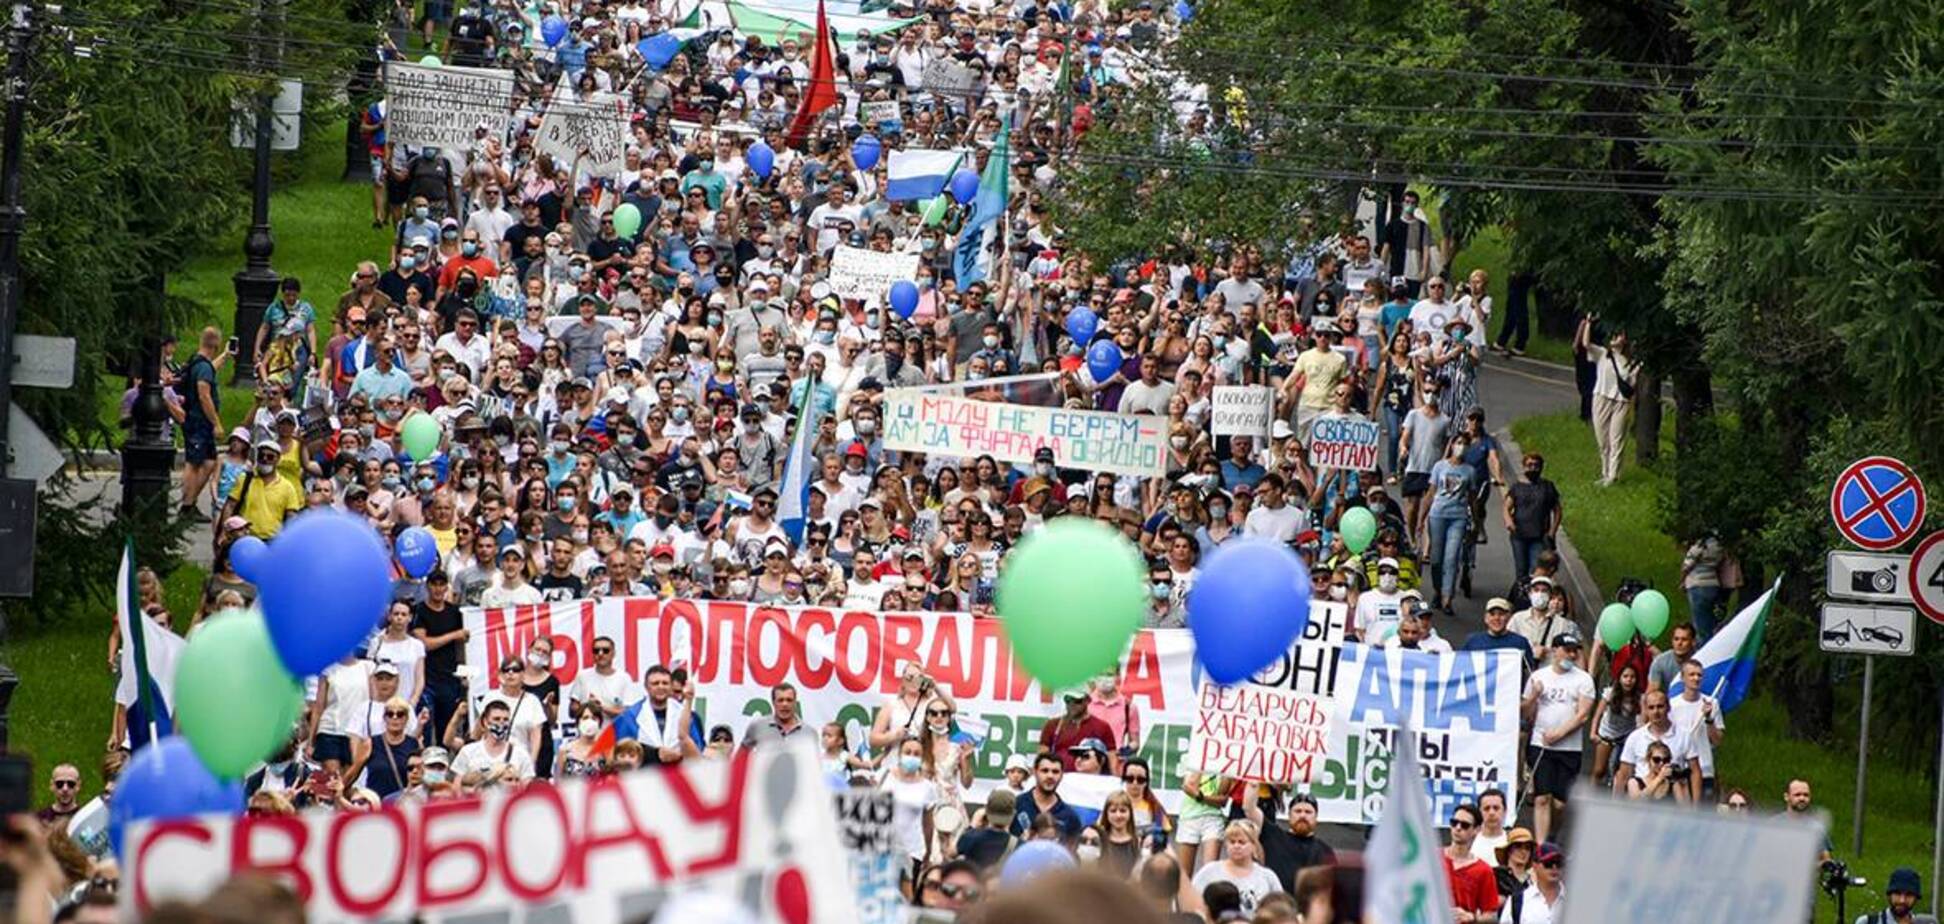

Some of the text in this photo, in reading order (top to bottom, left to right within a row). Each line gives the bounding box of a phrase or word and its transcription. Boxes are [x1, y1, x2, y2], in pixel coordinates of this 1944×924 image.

[433, 74, 501, 94] ЗАЩИТЫ
[923, 421, 950, 448] ЗА
[997, 406, 1036, 449] НЕ
[1313, 419, 1379, 446] СВОБОДУ
[1312, 441, 1377, 468] ФУРГАЛУ
[1302, 607, 1343, 642] Ы-
[485, 600, 595, 690] МЫ
[1201, 682, 1326, 728] БЕЛАРУСЬ
[1196, 710, 1327, 756] ХАБАРОВСК
[1200, 737, 1314, 785] РЯДОМ
